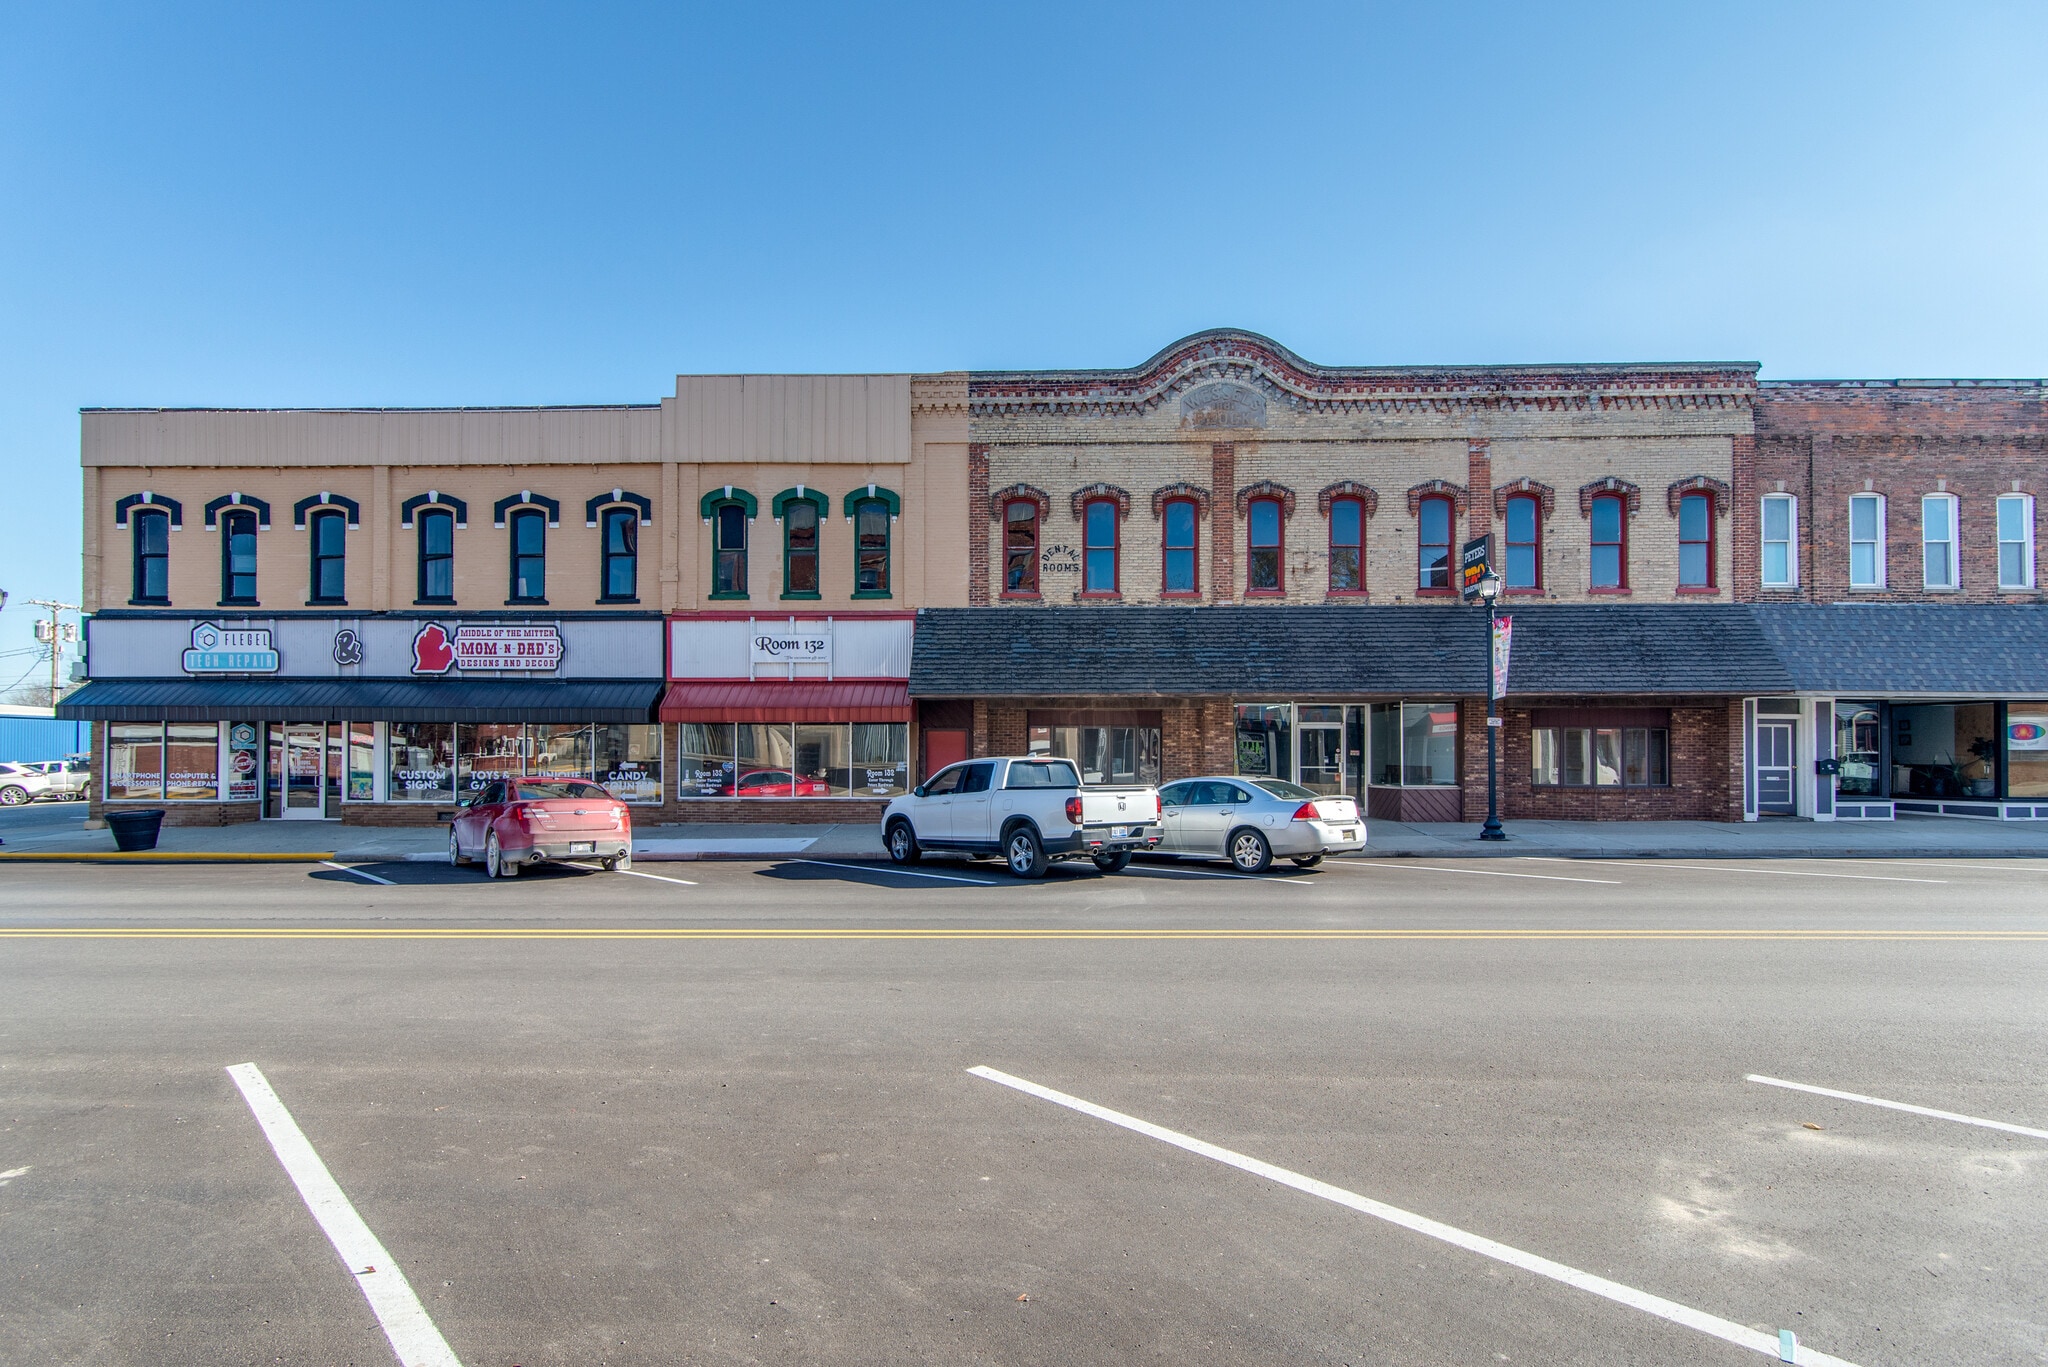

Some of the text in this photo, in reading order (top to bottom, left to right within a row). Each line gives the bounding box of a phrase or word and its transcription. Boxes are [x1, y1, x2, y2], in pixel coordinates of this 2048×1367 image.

[1185, 386, 1261, 411] WESSELS
[1041, 544, 1080, 562] DENTAL
[460, 629, 555, 637] MIDDLE OF THE MITTEN
[224, 633, 268, 646] FLEGEL
[460, 642, 498, 655] MOM
[755, 636, 825, 656] Room 132
[190, 654, 273, 668] TECH REPAIR
[460, 659, 555, 667] DESIGNS AND DECOR
[111, 772, 161, 780] SMARTPHONE
[169, 772, 209, 780] COMPUTER
[398, 770, 446, 780] CUSTOM
[470, 770, 510, 780] TOYS &
[608, 771, 649, 781] CANDY
[694, 769, 723, 778] Room 132
[866, 769, 883, 778] Room
[884, 769, 895, 777] 132
[111, 780, 161, 788] ACCESSORIES
[166, 780, 219, 788] PHONE REPAIR
[405, 780, 439, 790] SIGNS
[602, 781, 655, 791] COUNTER
